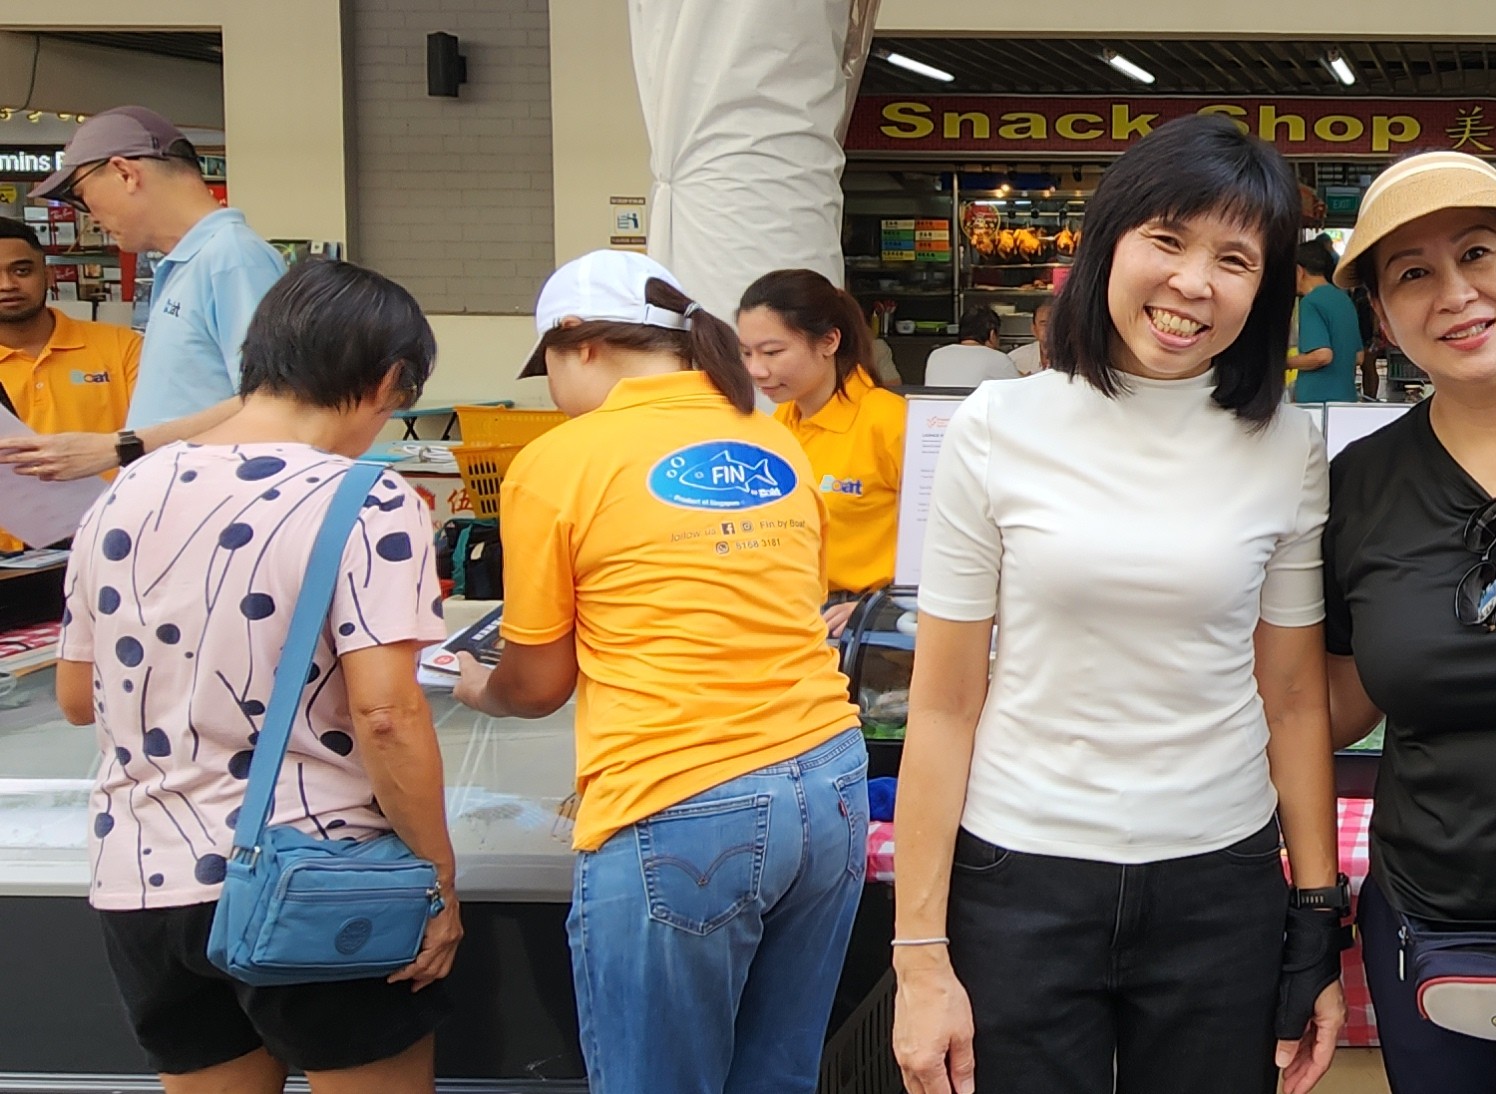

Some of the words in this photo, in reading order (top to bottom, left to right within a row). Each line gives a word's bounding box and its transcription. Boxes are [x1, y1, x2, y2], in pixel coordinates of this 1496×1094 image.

[880, 101, 1160, 140] Snack
[712, 465, 745, 485] FIN
[760, 521, 775, 529] Fin
[777, 519, 787, 529] by
[789, 518, 806, 528] Boat
